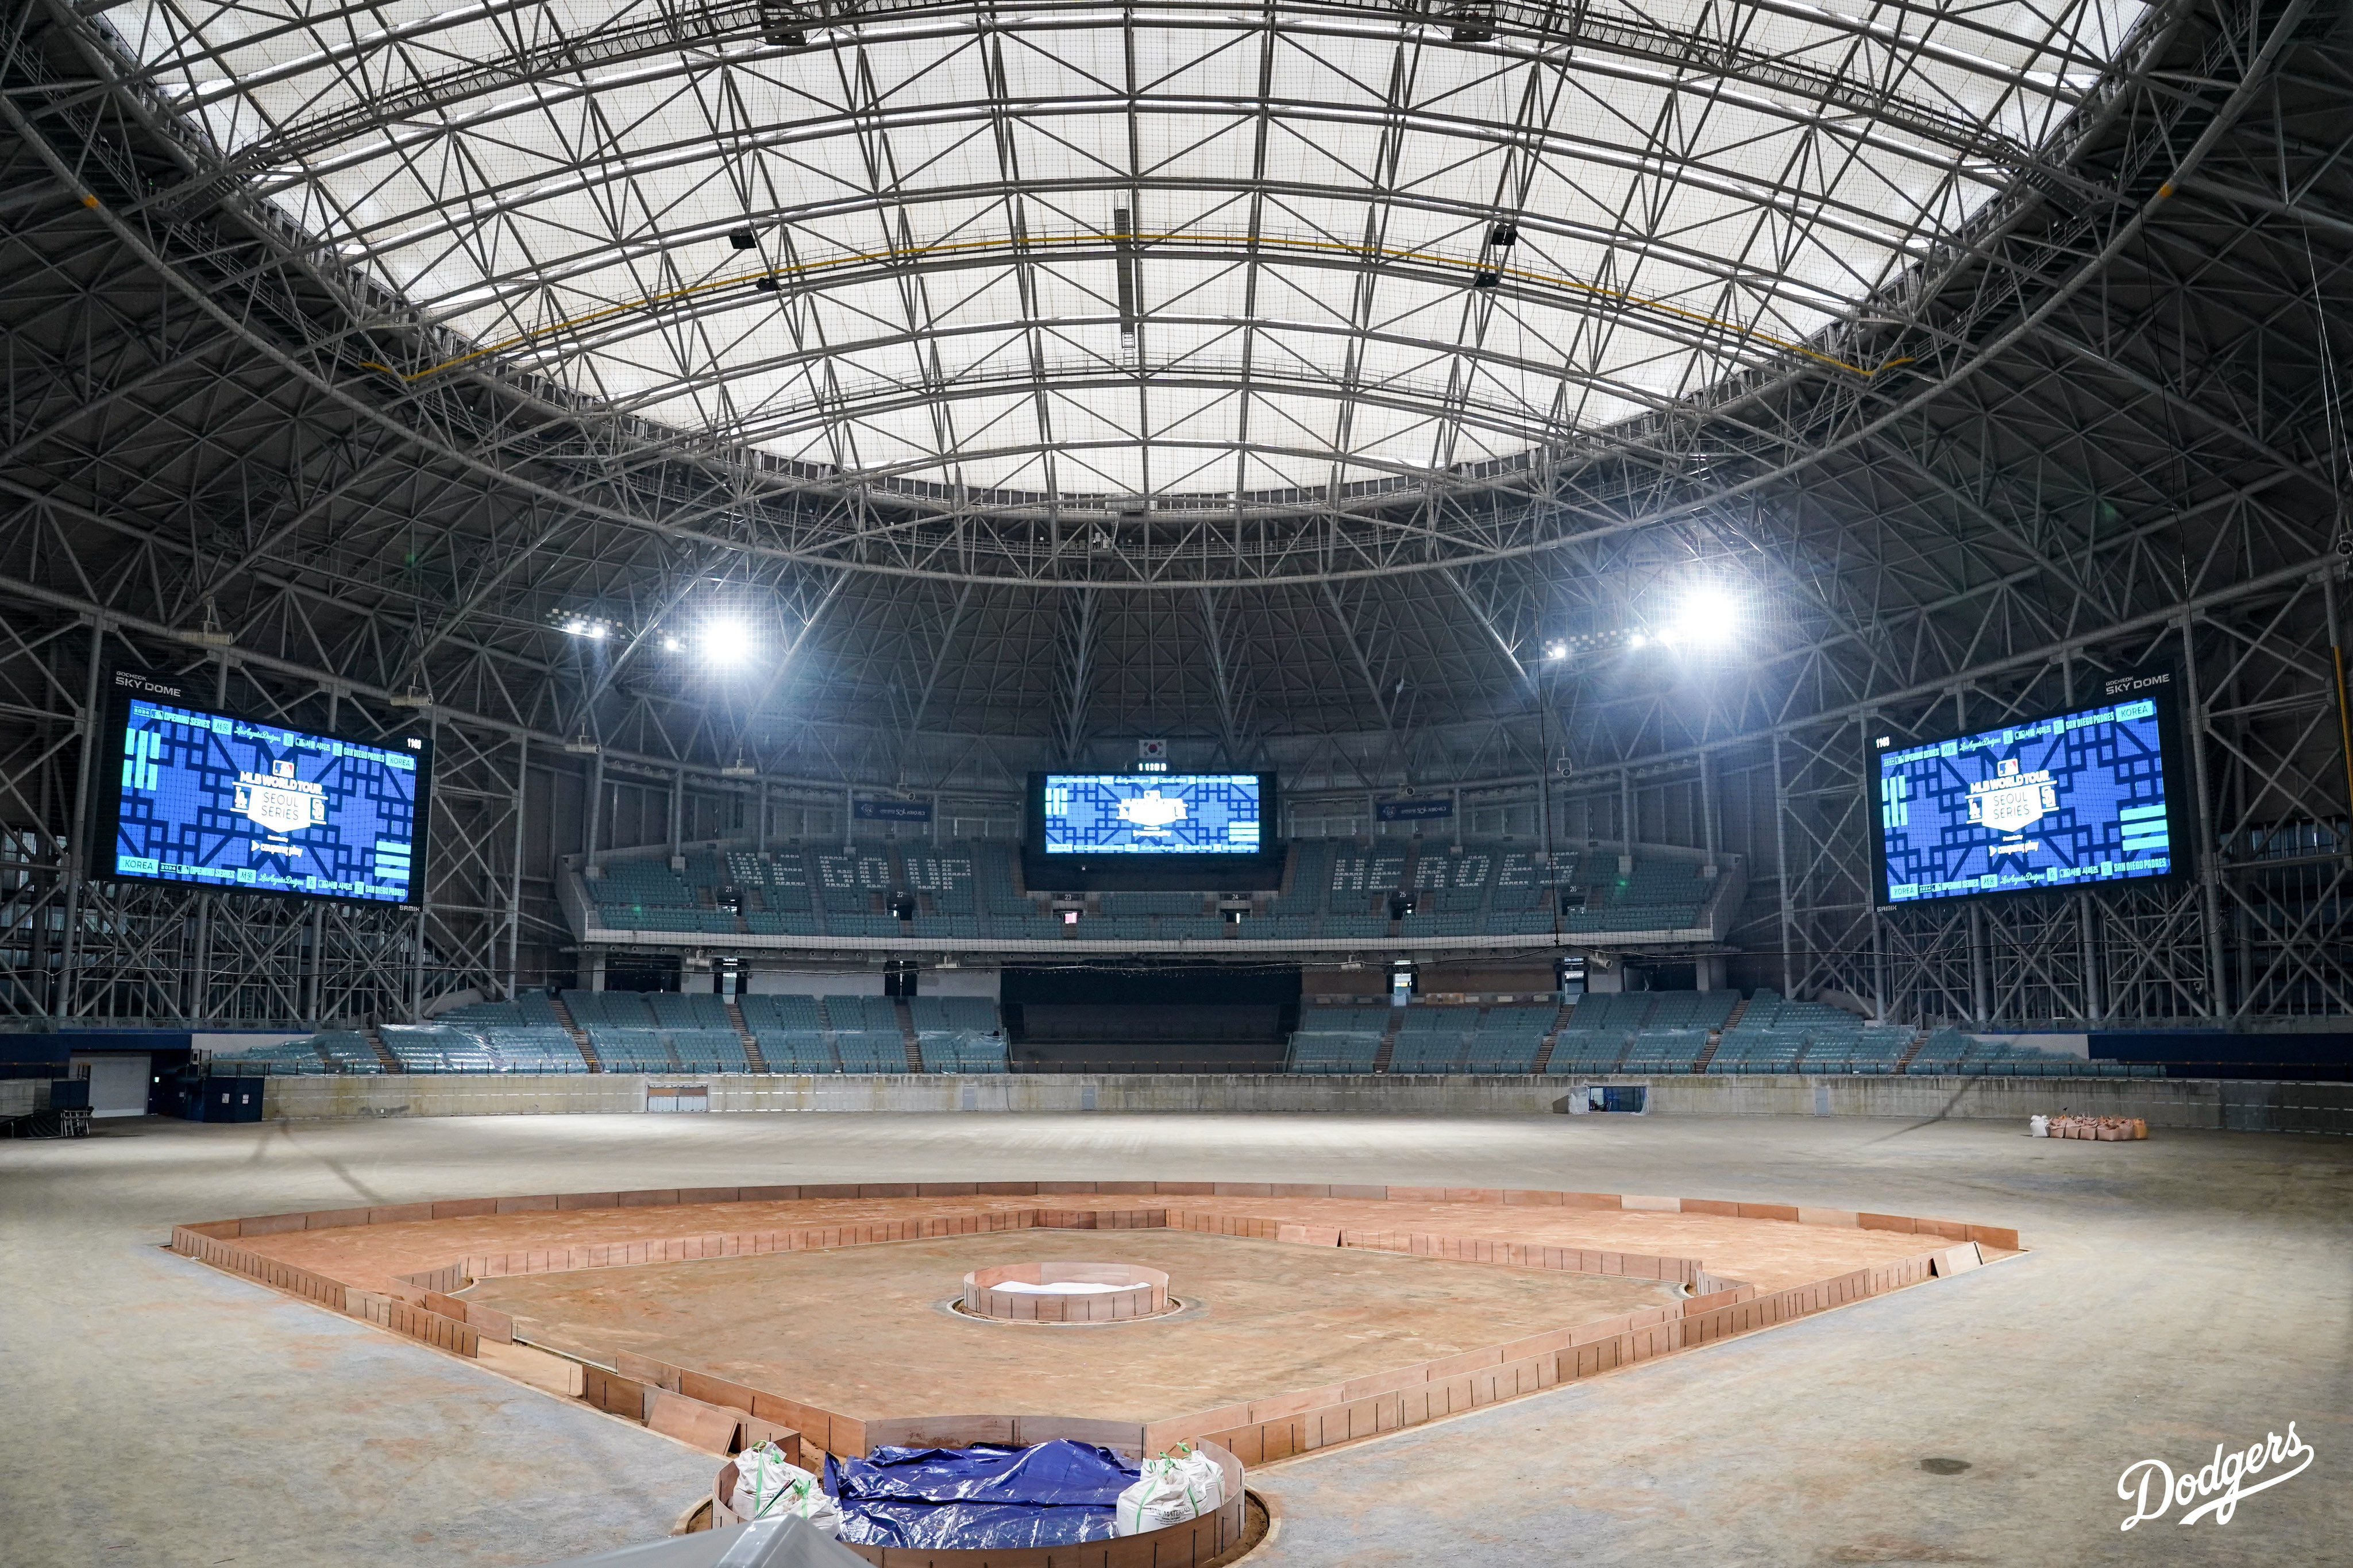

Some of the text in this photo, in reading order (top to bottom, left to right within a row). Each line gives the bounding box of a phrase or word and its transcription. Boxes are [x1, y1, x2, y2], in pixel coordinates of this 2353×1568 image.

[115, 677, 181, 697] SKY DOME
[2106, 674, 2170, 695] SKY DOME
[2121, 705, 2148, 717] KOREA
[215, 723, 229, 732] 서울
[2066, 720, 2077, 730] SAN
[2077, 716, 2094, 728] DIEGO
[2093, 711, 2115, 725] PADRES
[344, 747, 353, 756] SAN
[390, 757, 410, 767] KOREA
[240, 771, 323, 795] MLB WORLD TOUR
[1970, 770, 2050, 794] MLB WORLD TOUR
[263, 792, 299, 808] SEOUL
[1993, 791, 2028, 806] SEOUL
[261, 805, 299, 820] SERIES
[1993, 805, 2030, 820] SERIES
[288, 844, 303, 858] play
[2024, 840, 2039, 853] play
[125, 860, 153, 871] KOREA
[726, 852, 971, 890] WE GO UP
[1332, 852, 1579, 890] HEROES
[2114, 863, 2126, 872] SAN
[2126, 860, 2144, 871] DIEGO
[2143, 858, 2166, 868] PADRES
[241, 872, 253, 881] 서울
[365, 885, 375, 894] SAN
[375, 886, 388, 895] DIEGO
[388, 887, 406, 897] PADRES
[1894, 887, 1914, 896] KOREA
[1163, 1507, 1191, 1517] MATERIALS
